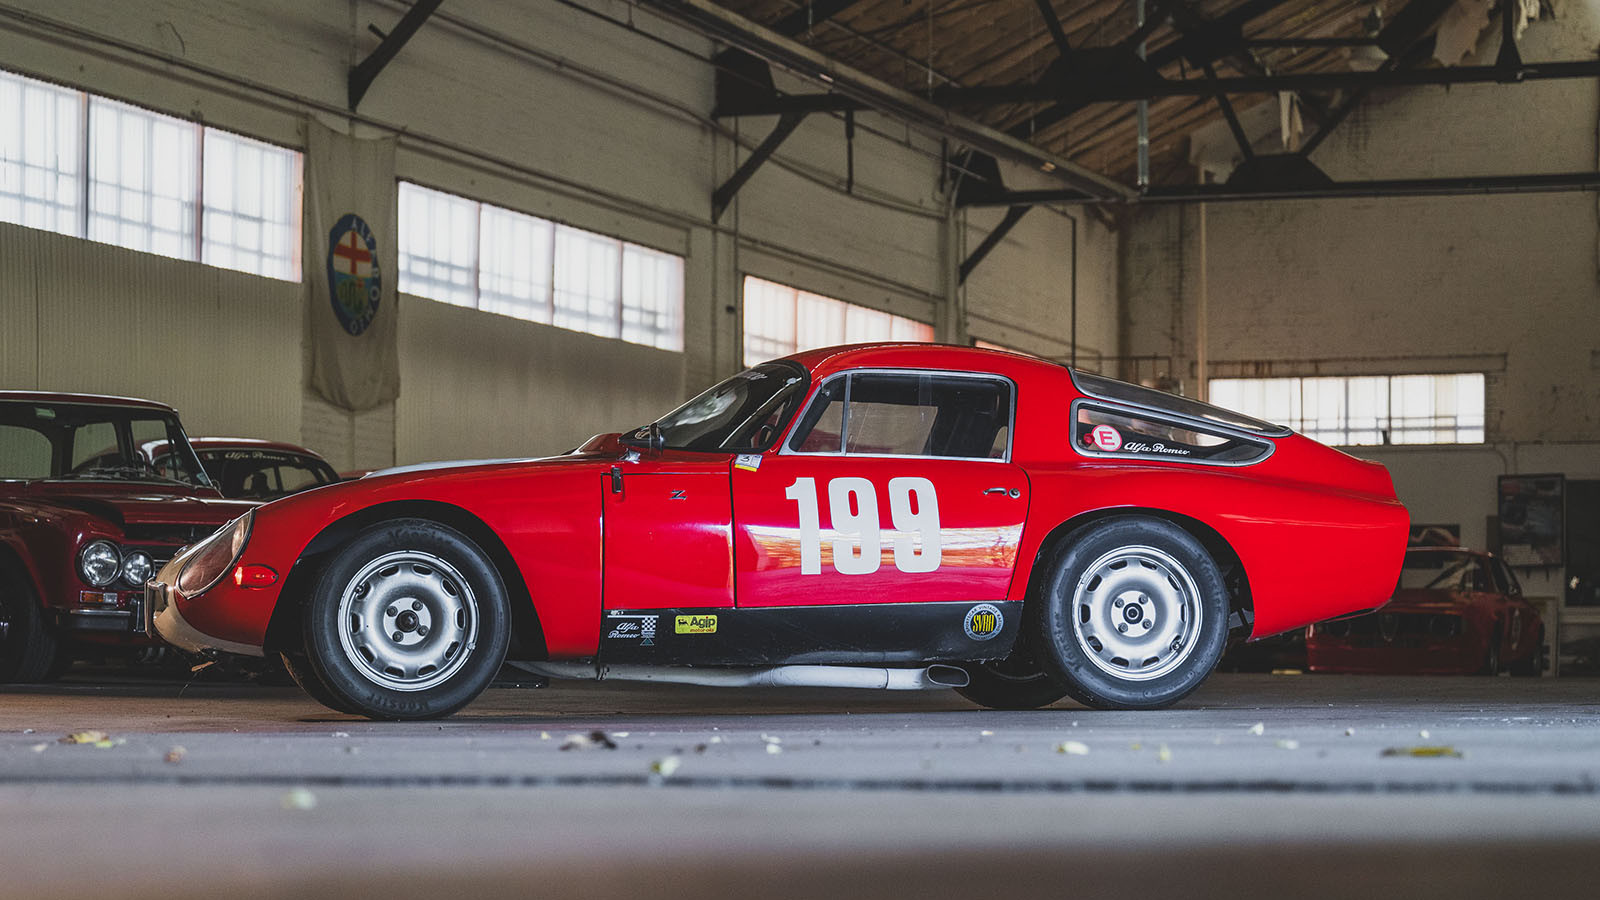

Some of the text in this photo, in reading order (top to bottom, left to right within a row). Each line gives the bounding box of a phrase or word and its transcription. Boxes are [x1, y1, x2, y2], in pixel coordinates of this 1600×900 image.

[1099, 431, 1115, 446] E
[1124, 442, 1190, 455] Alfa Romeo
[785, 476, 942, 575] 199
[616, 622, 640, 633] Alfa
[690, 616, 716, 628] Agip
[608, 630, 641, 639] Romeo
